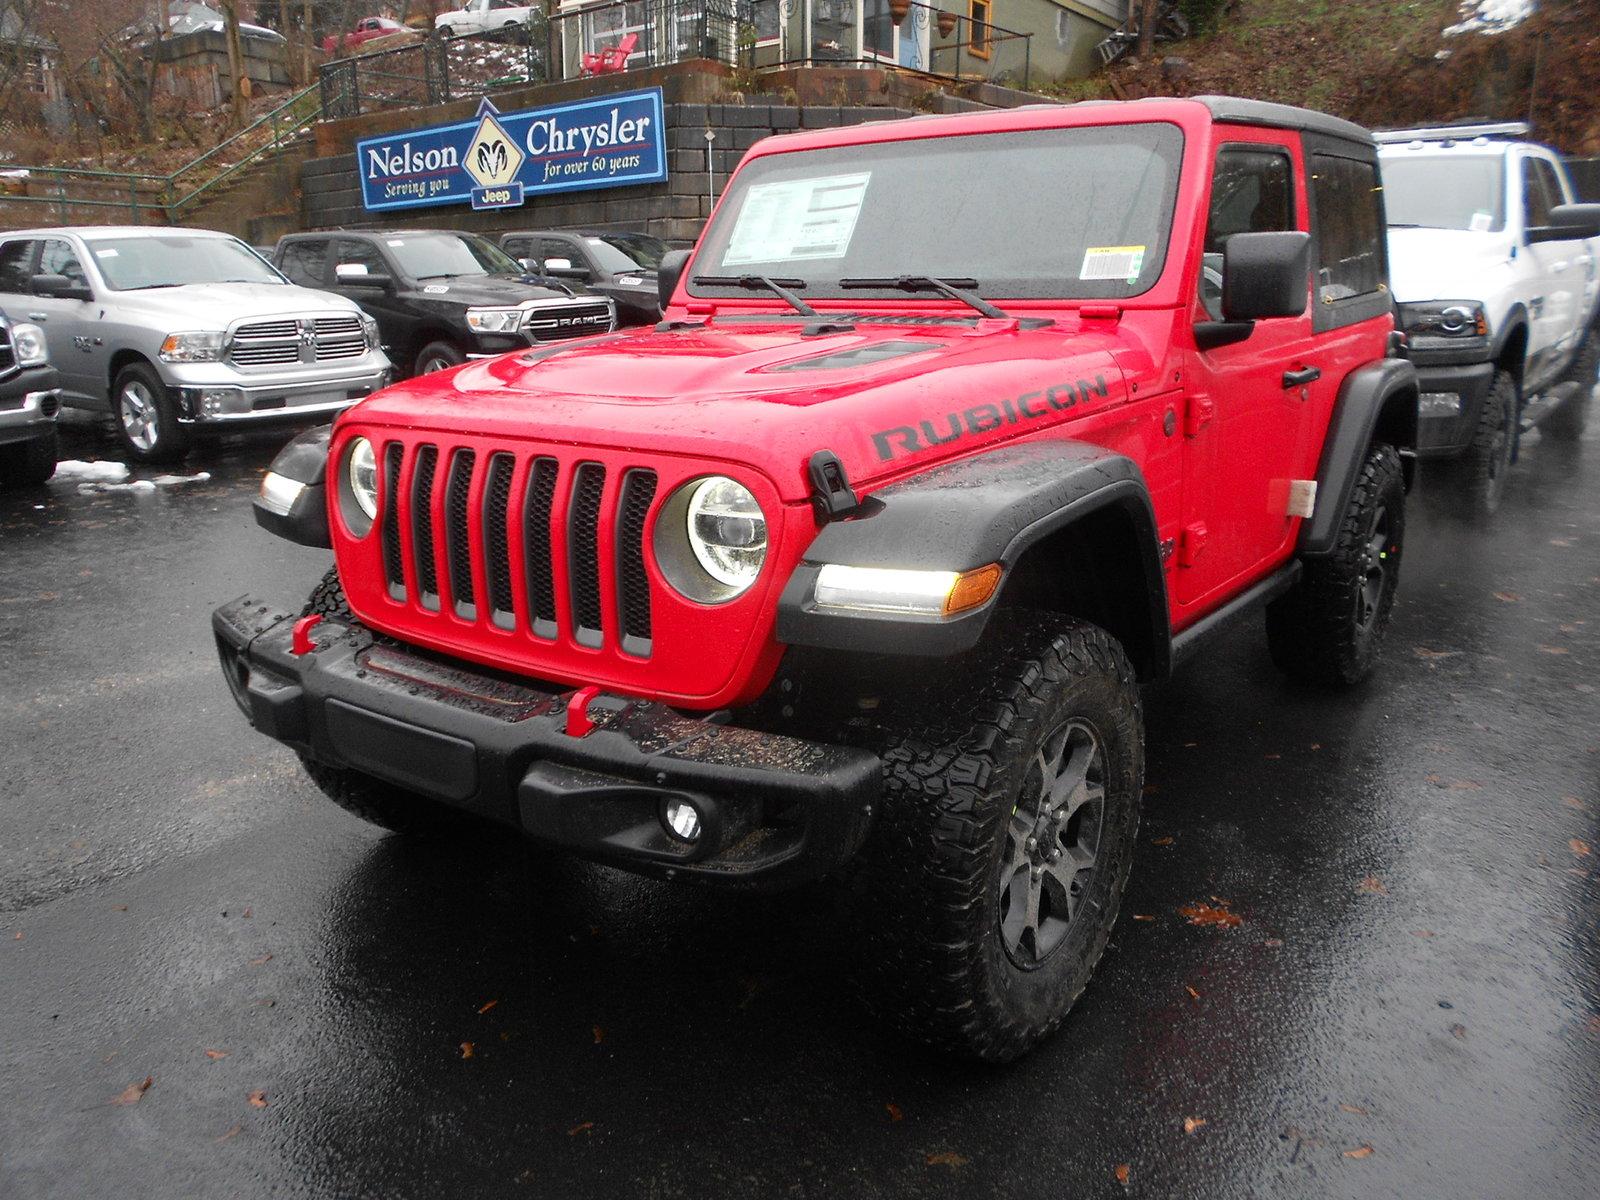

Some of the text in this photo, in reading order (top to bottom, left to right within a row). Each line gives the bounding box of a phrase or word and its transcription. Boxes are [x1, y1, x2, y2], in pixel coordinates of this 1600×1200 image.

[368, 107, 650, 178] Nelson Chrysler
[542, 154, 640, 182] for over 60 years
[384, 178, 449, 199] Serving you
[481, 189, 511, 204] Jeep
[559, 316, 598, 327] RAM
[871, 375, 1108, 460] RUBICON
